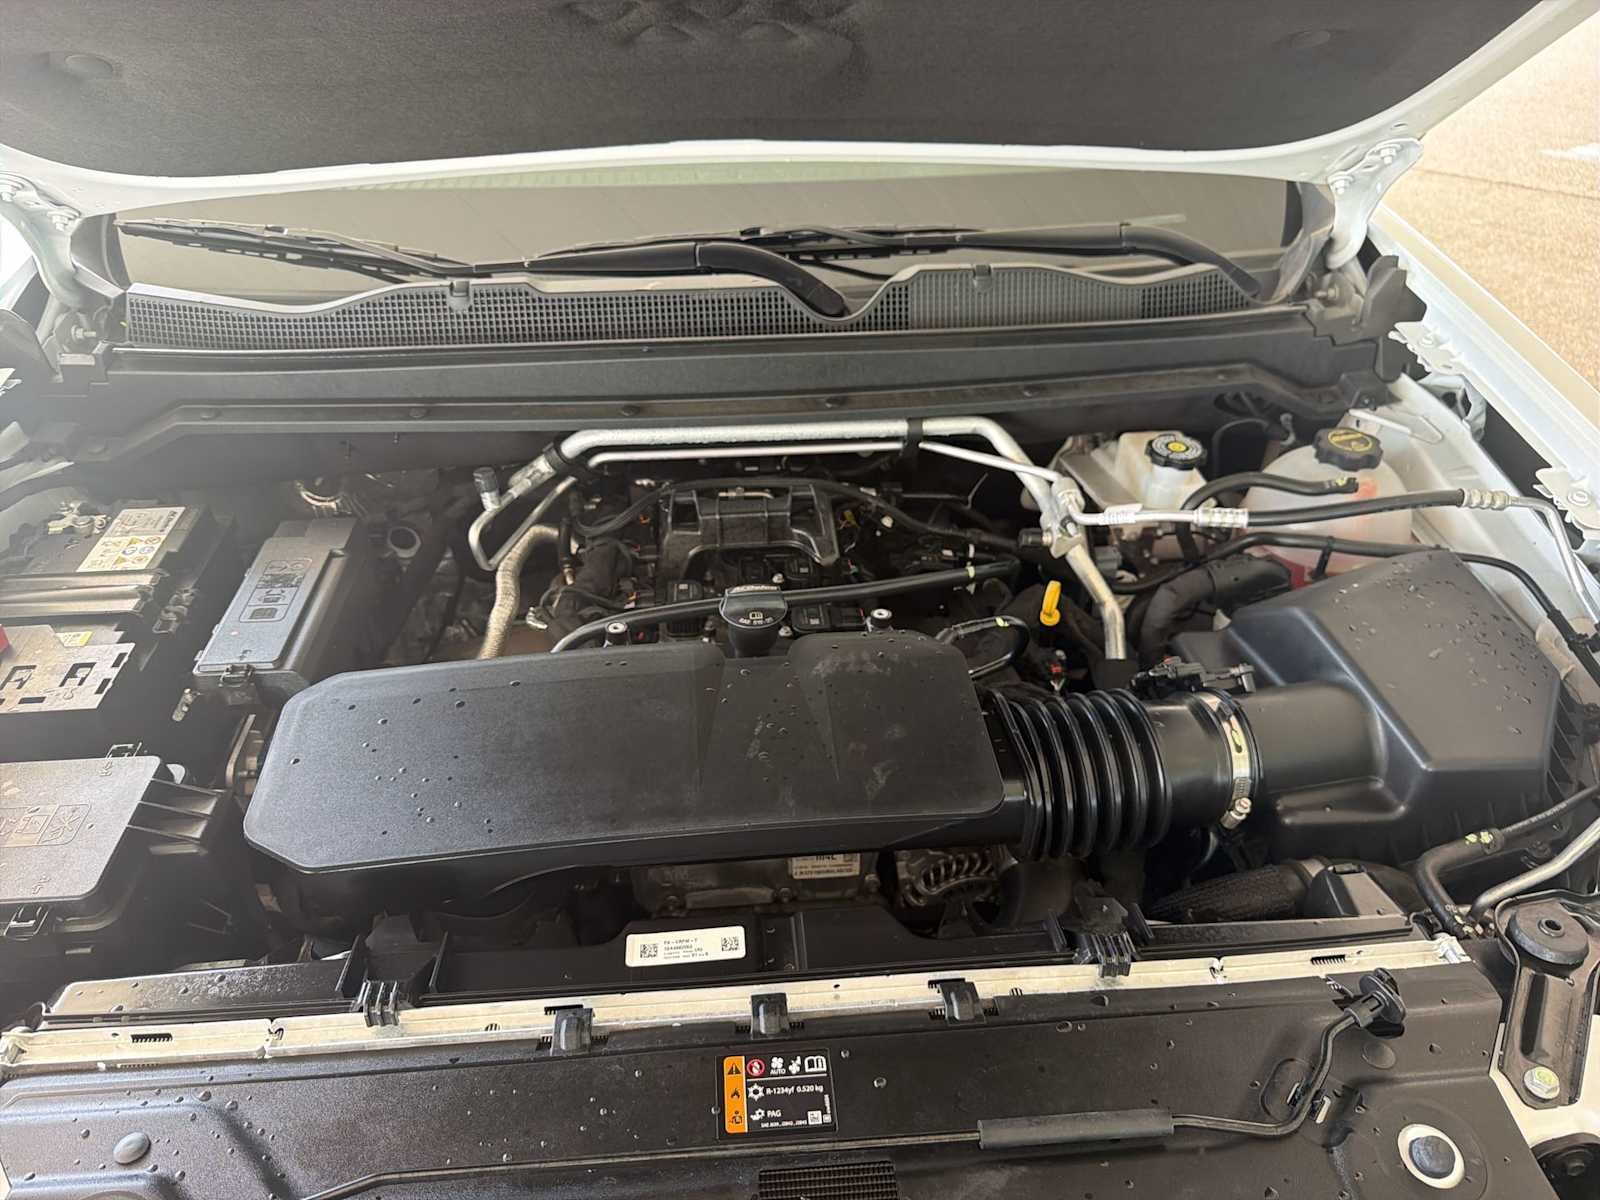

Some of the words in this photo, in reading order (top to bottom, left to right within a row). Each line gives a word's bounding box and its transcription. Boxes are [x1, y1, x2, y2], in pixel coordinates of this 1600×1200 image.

[766, 1086, 795, 1095] R-1234yf
[796, 1085, 814, 1093] 0.520
[815, 1085, 824, 1093] kg
[767, 1110, 782, 1118] PAG
